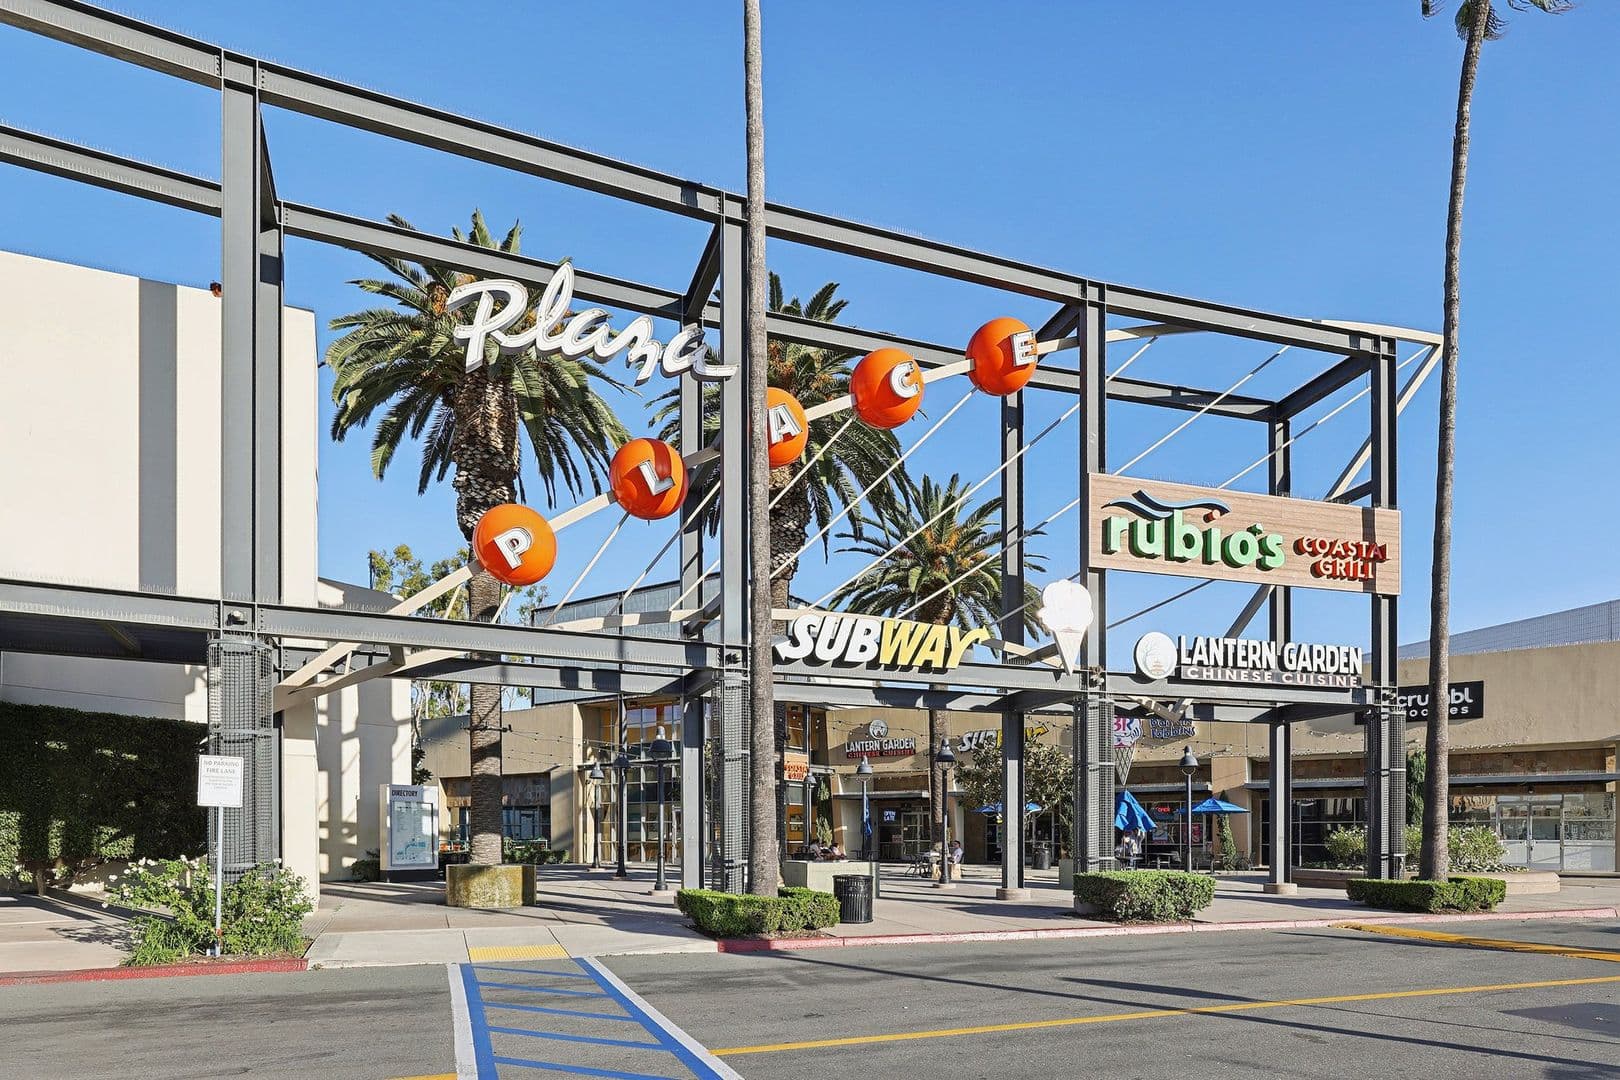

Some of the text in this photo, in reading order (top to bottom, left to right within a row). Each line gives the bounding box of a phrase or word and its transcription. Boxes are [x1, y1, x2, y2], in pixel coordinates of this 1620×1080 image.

[449, 261, 739, 385] Plaza
[1103, 509, 1286, 571] rubio's
[1315, 556, 1374, 579] GRILL
[774, 613, 990, 671] SUBWAY
[1180, 635, 1362, 674] LANTERN GARDEN
[1187, 667, 1358, 687] CHINESE CUISINE
[1396, 687, 1474, 708] crubl
[845, 737, 915, 752] LANTERN GARDEN
[391, 789, 418, 797] DIRECTORY
